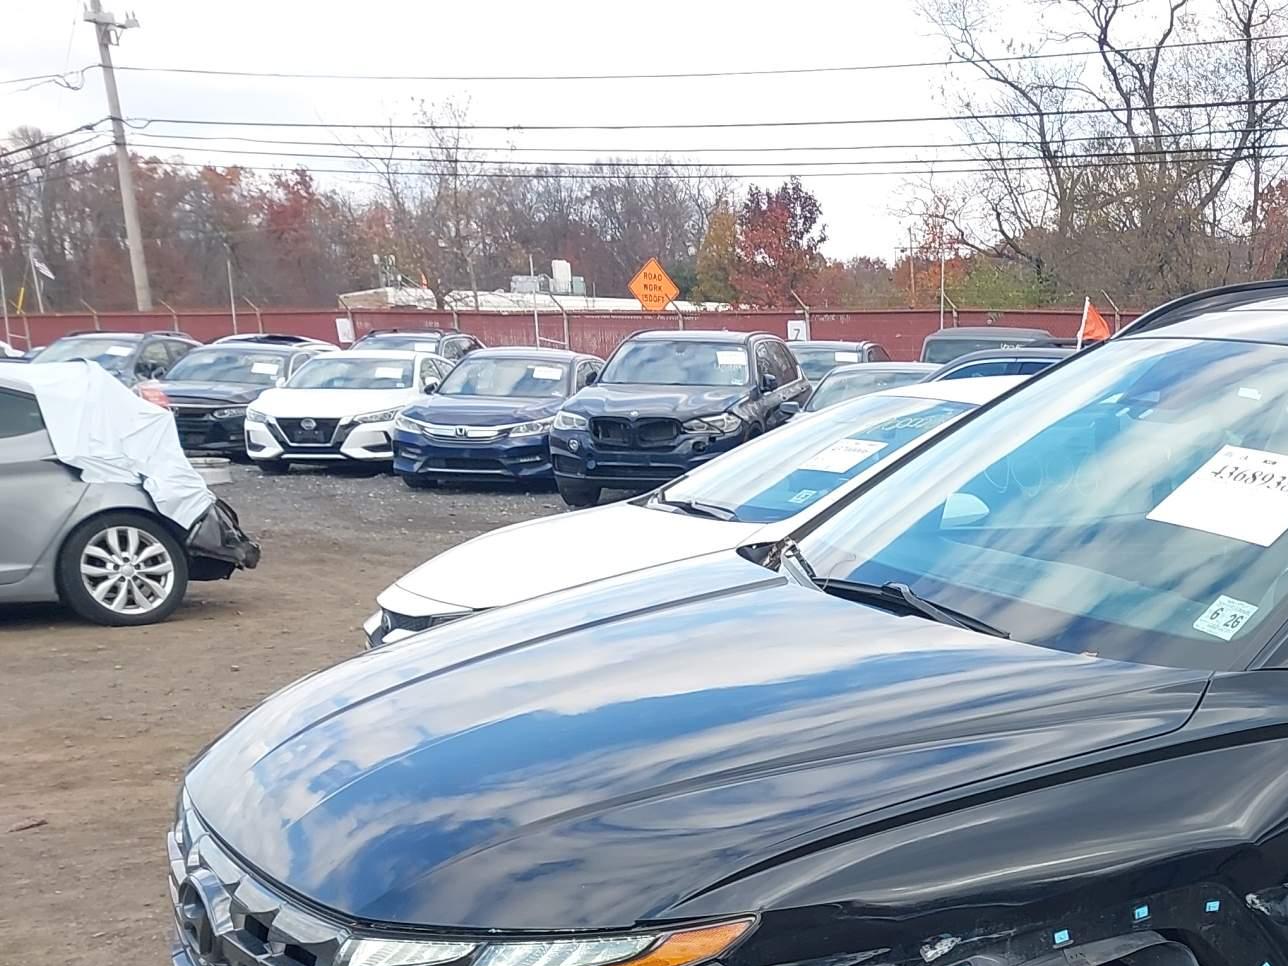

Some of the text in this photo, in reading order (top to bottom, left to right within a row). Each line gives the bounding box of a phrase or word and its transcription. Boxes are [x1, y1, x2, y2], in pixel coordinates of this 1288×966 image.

[643, 271, 663, 281] ROAD
[643, 283, 662, 292] WORK
[793, 328, 801, 340] 7
